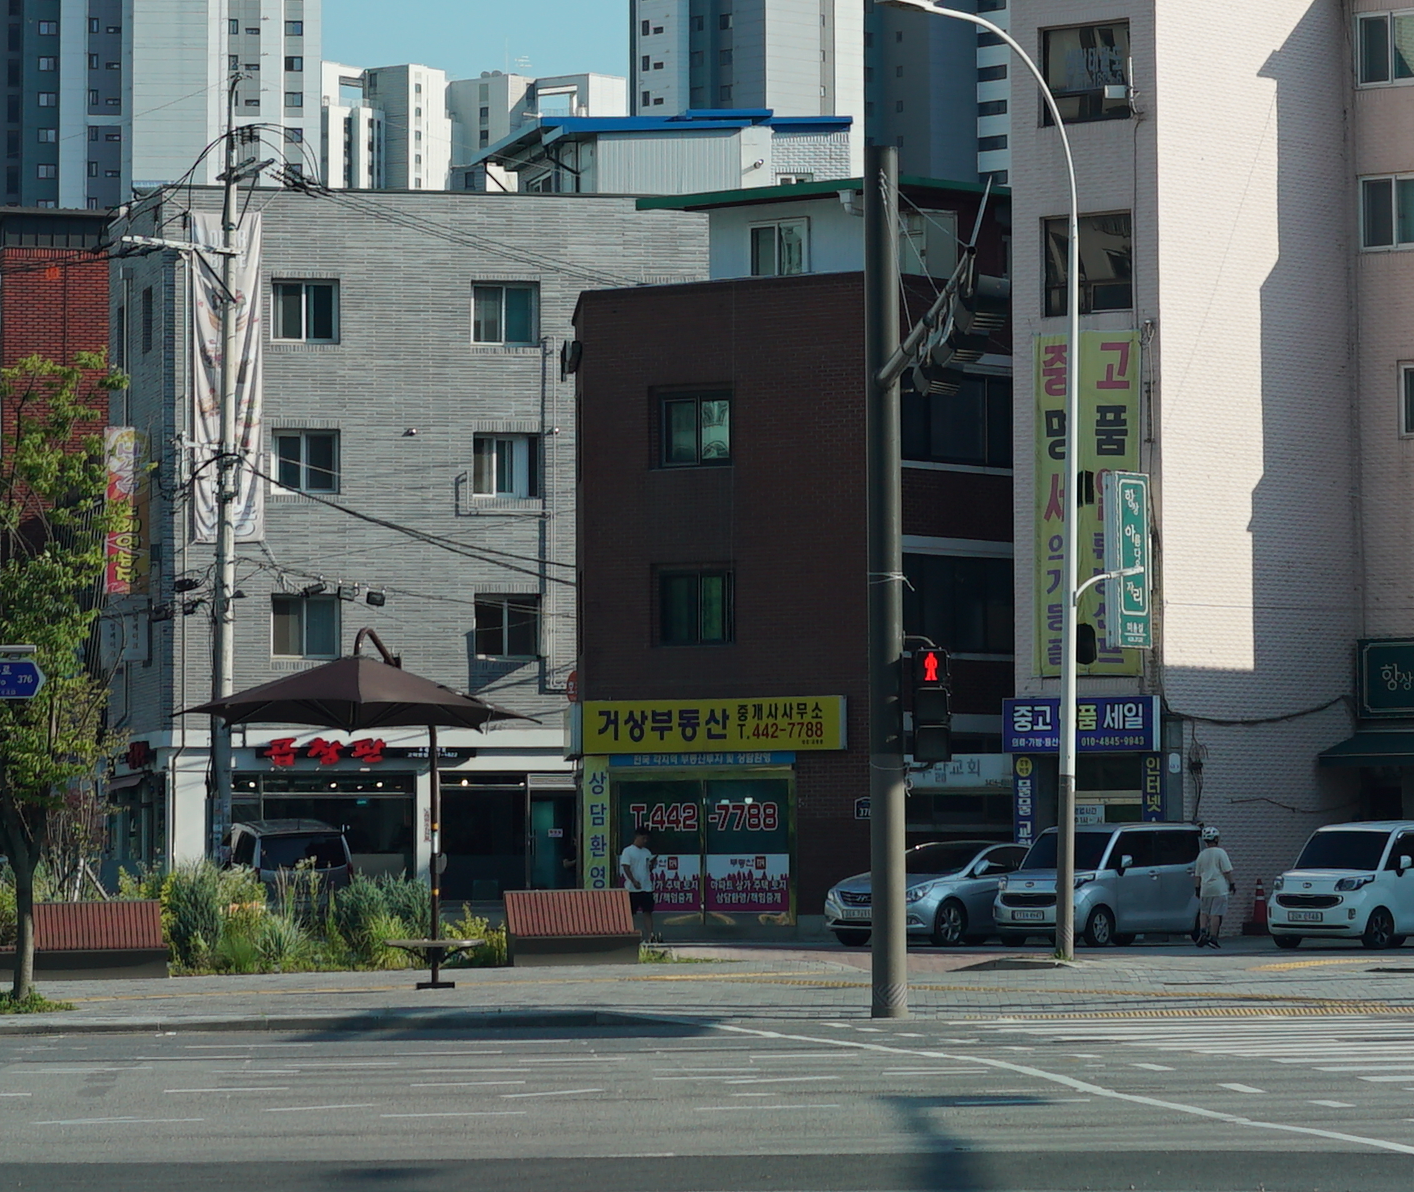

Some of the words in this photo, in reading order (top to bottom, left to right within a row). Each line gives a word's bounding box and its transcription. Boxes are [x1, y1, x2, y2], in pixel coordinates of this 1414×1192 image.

[17, 675, 33, 684] 376
[1380, 664, 1413, 691] 항상
[598, 709, 730, 742] 거상부동산
[737, 702, 824, 722] 중개사사무소
[1013, 705, 1052, 732] 중고
[1058, 704, 1098, 731] 품
[1103, 702, 1144, 730] 세일
[737, 721, 824, 740] T.442-7788
[263, 737, 387, 766] 곱창판
[1145, 757, 1162, 813] 인터넷
[588, 770, 608, 890] 상담환영
[630, 803, 698, 832] T.442
[708, 802, 778, 832] -7788
